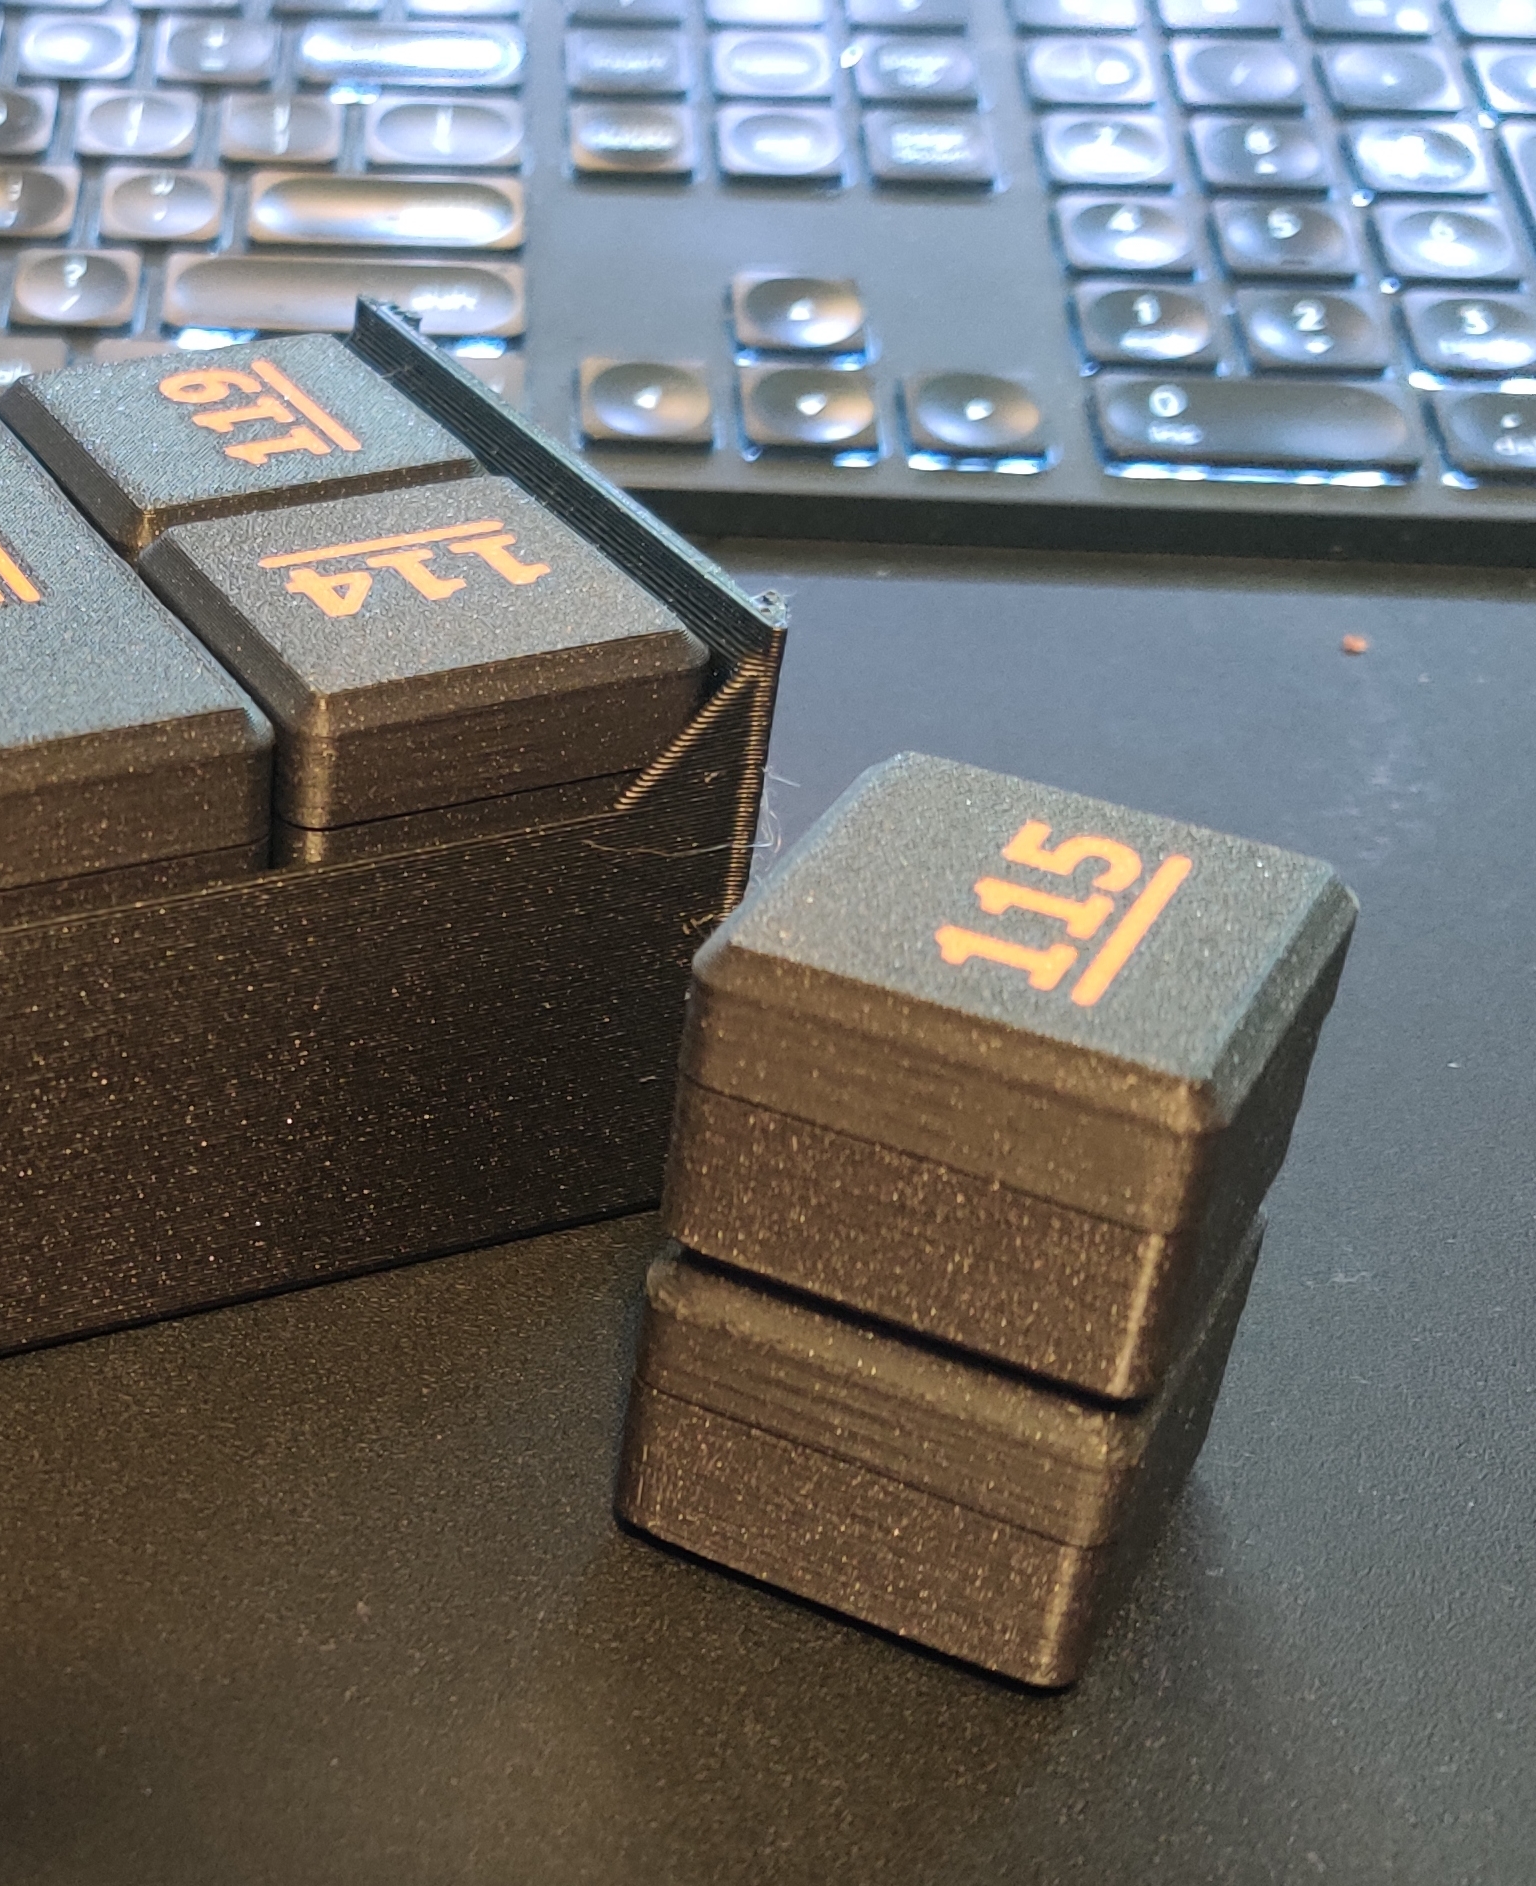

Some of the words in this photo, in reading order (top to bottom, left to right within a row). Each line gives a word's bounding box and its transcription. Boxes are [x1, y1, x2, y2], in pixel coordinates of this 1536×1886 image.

[1293, 300, 1327, 333] 2
[158, 367, 333, 466] 119
[284, 533, 552, 619] 114
[933, 819, 1142, 992] 115
